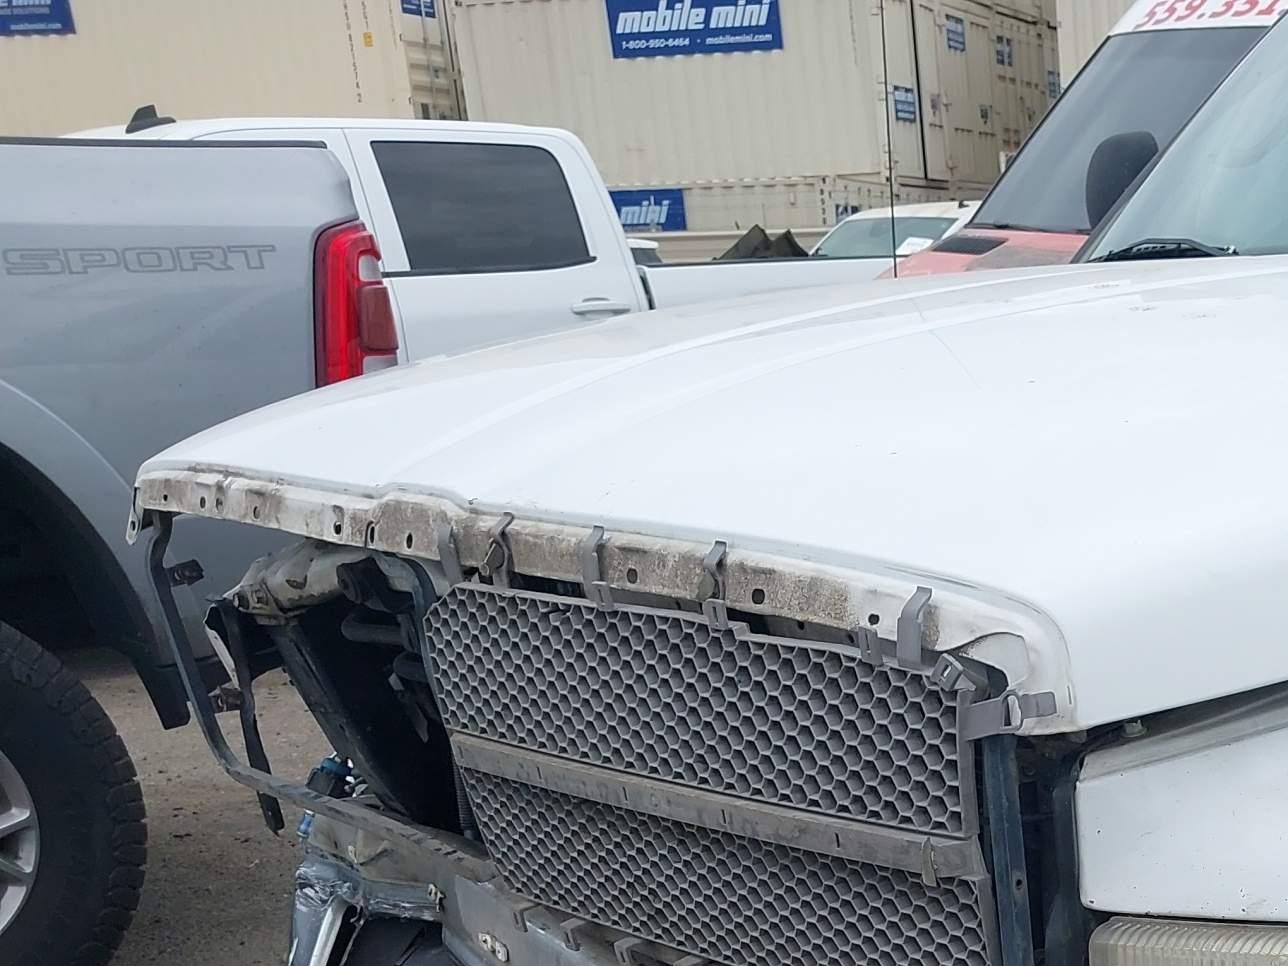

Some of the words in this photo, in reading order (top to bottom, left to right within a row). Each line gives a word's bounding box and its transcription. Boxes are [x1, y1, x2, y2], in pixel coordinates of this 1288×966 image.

[616, 0, 706, 34] mobile
[709, 0, 770, 29] mini
[620, 200, 670, 225] mini
[3, 244, 277, 276] SPORT
